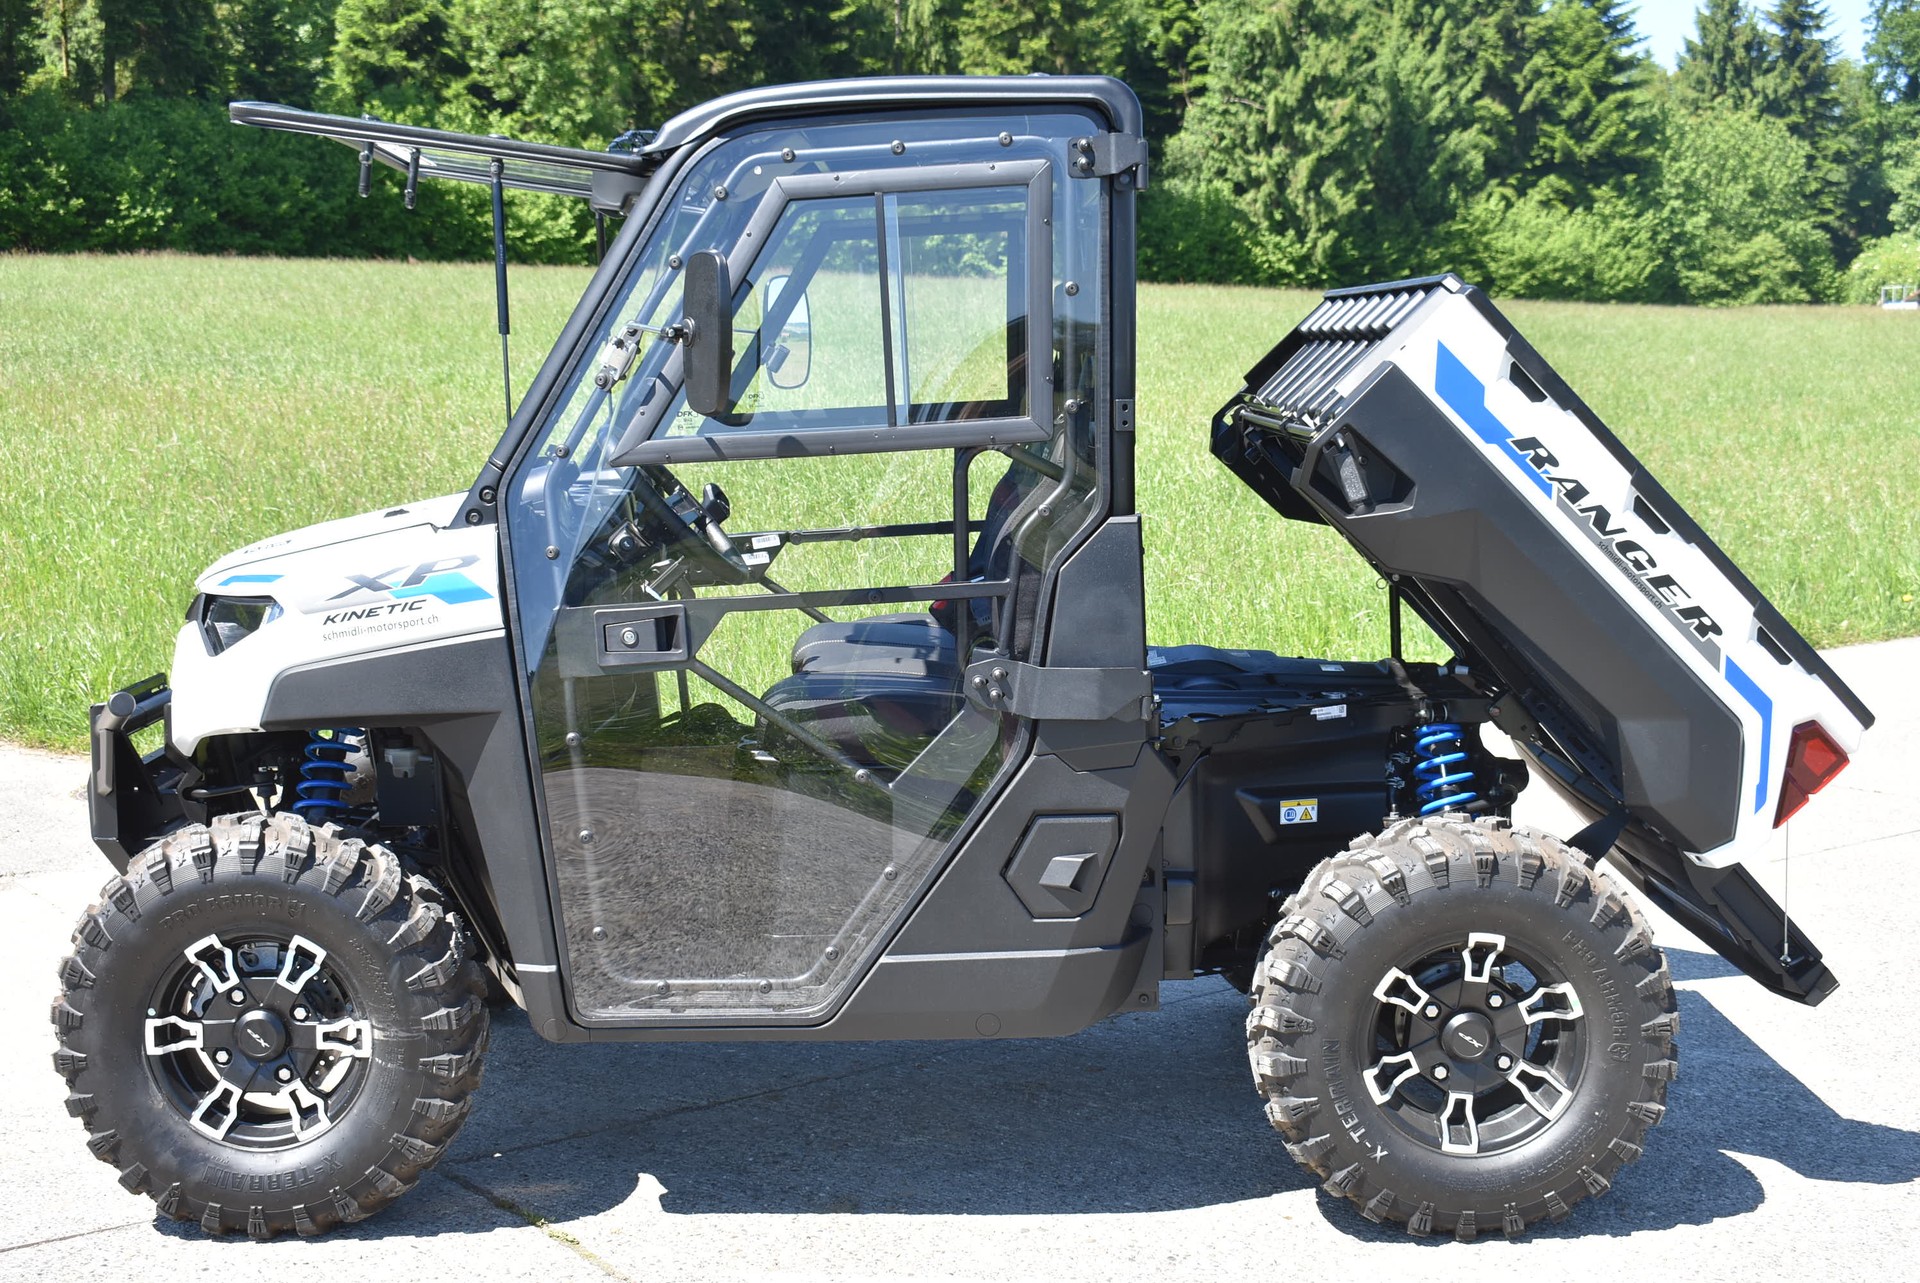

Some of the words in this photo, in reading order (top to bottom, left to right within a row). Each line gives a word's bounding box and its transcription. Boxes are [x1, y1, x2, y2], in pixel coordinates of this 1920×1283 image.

[1509, 436, 1723, 640] RANGER
[324, 554, 481, 602] XP
[1597, 541, 1663, 610] schmidli-motorsport.ch
[322, 599, 428, 626] KINETIC
[322, 614, 440, 642] schmidli-motorsport.ch
[1322, 1038, 1390, 1165] X-TERRAIN
[201, 1150, 344, 1194] X-TERRAIN
